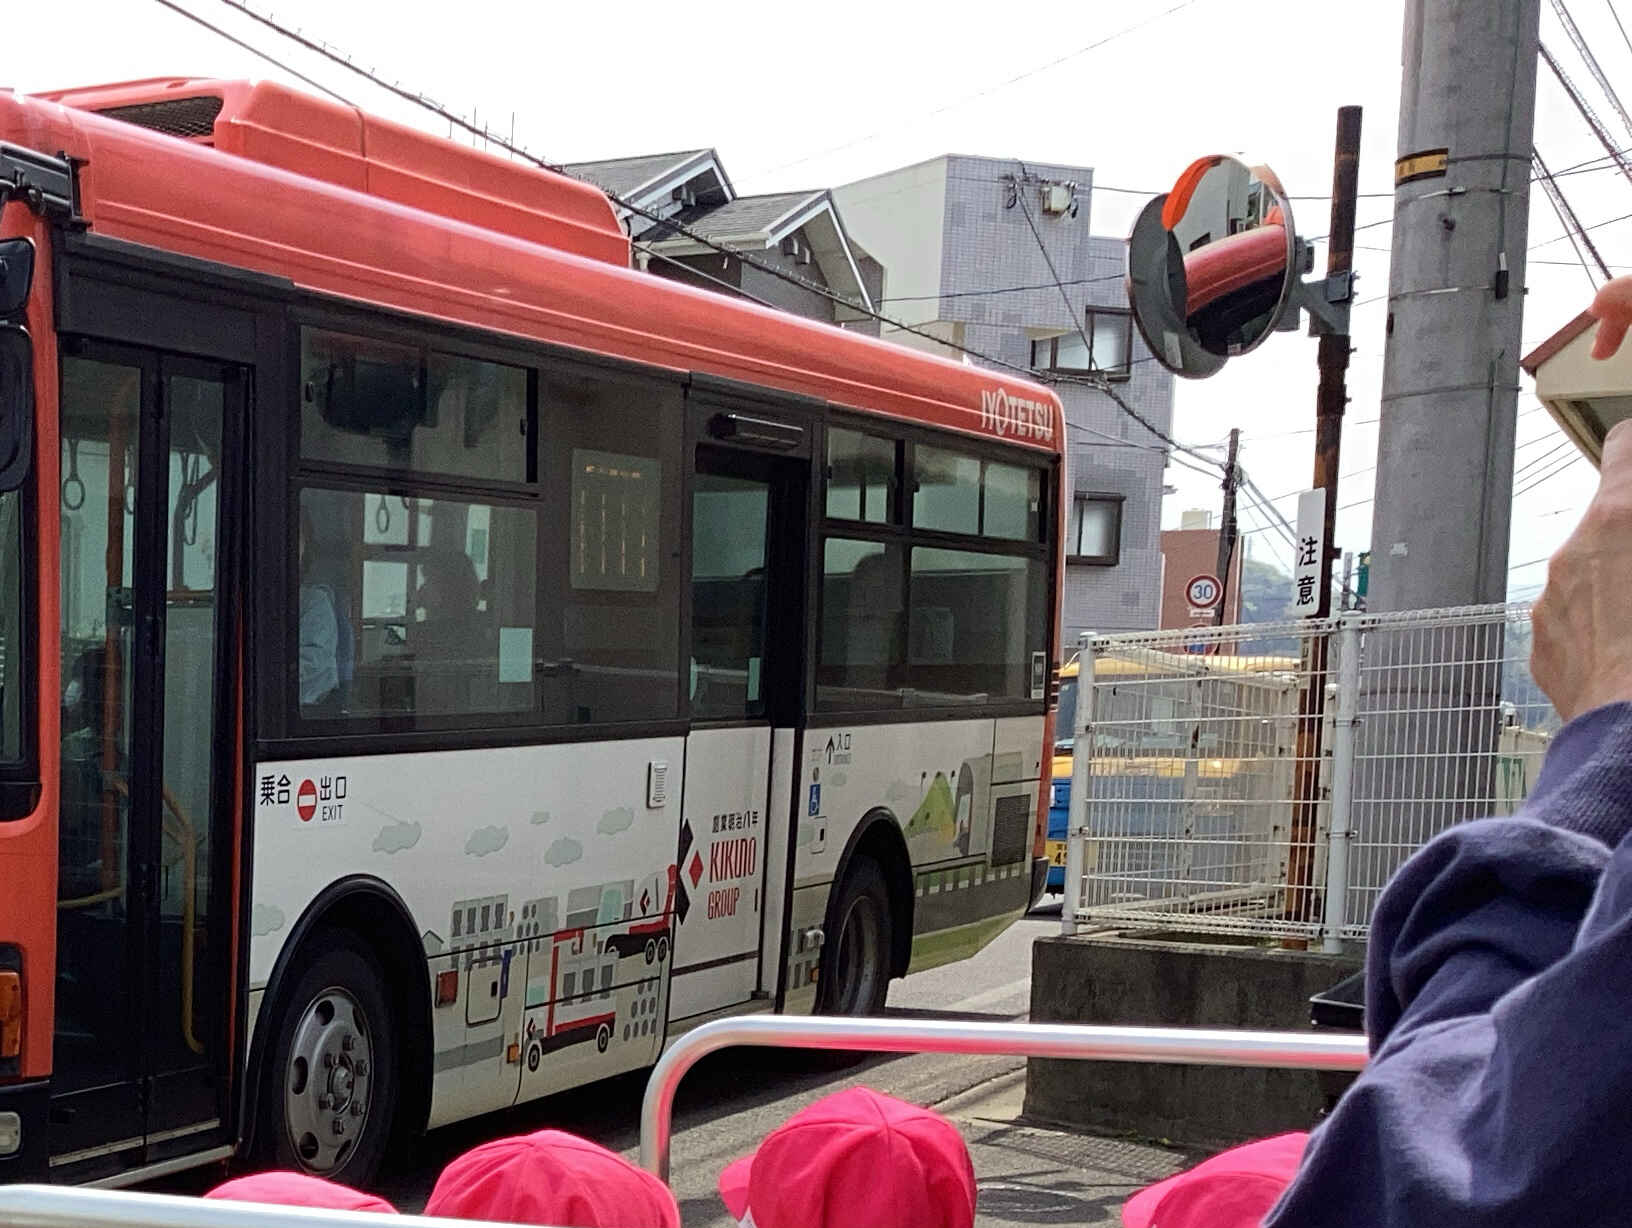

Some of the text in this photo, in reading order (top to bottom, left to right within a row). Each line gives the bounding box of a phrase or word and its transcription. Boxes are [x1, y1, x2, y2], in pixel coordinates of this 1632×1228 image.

[981, 387, 1054, 442] IYOTETSU
[1296, 536, 1318, 607] 注意
[1192, 583, 1214, 600] 30
[835, 732, 852, 751] 入口
[260, 774, 347, 806] 乗合 出口
[321, 804, 345, 822] EXIT
[707, 886, 740, 920] GROUP
